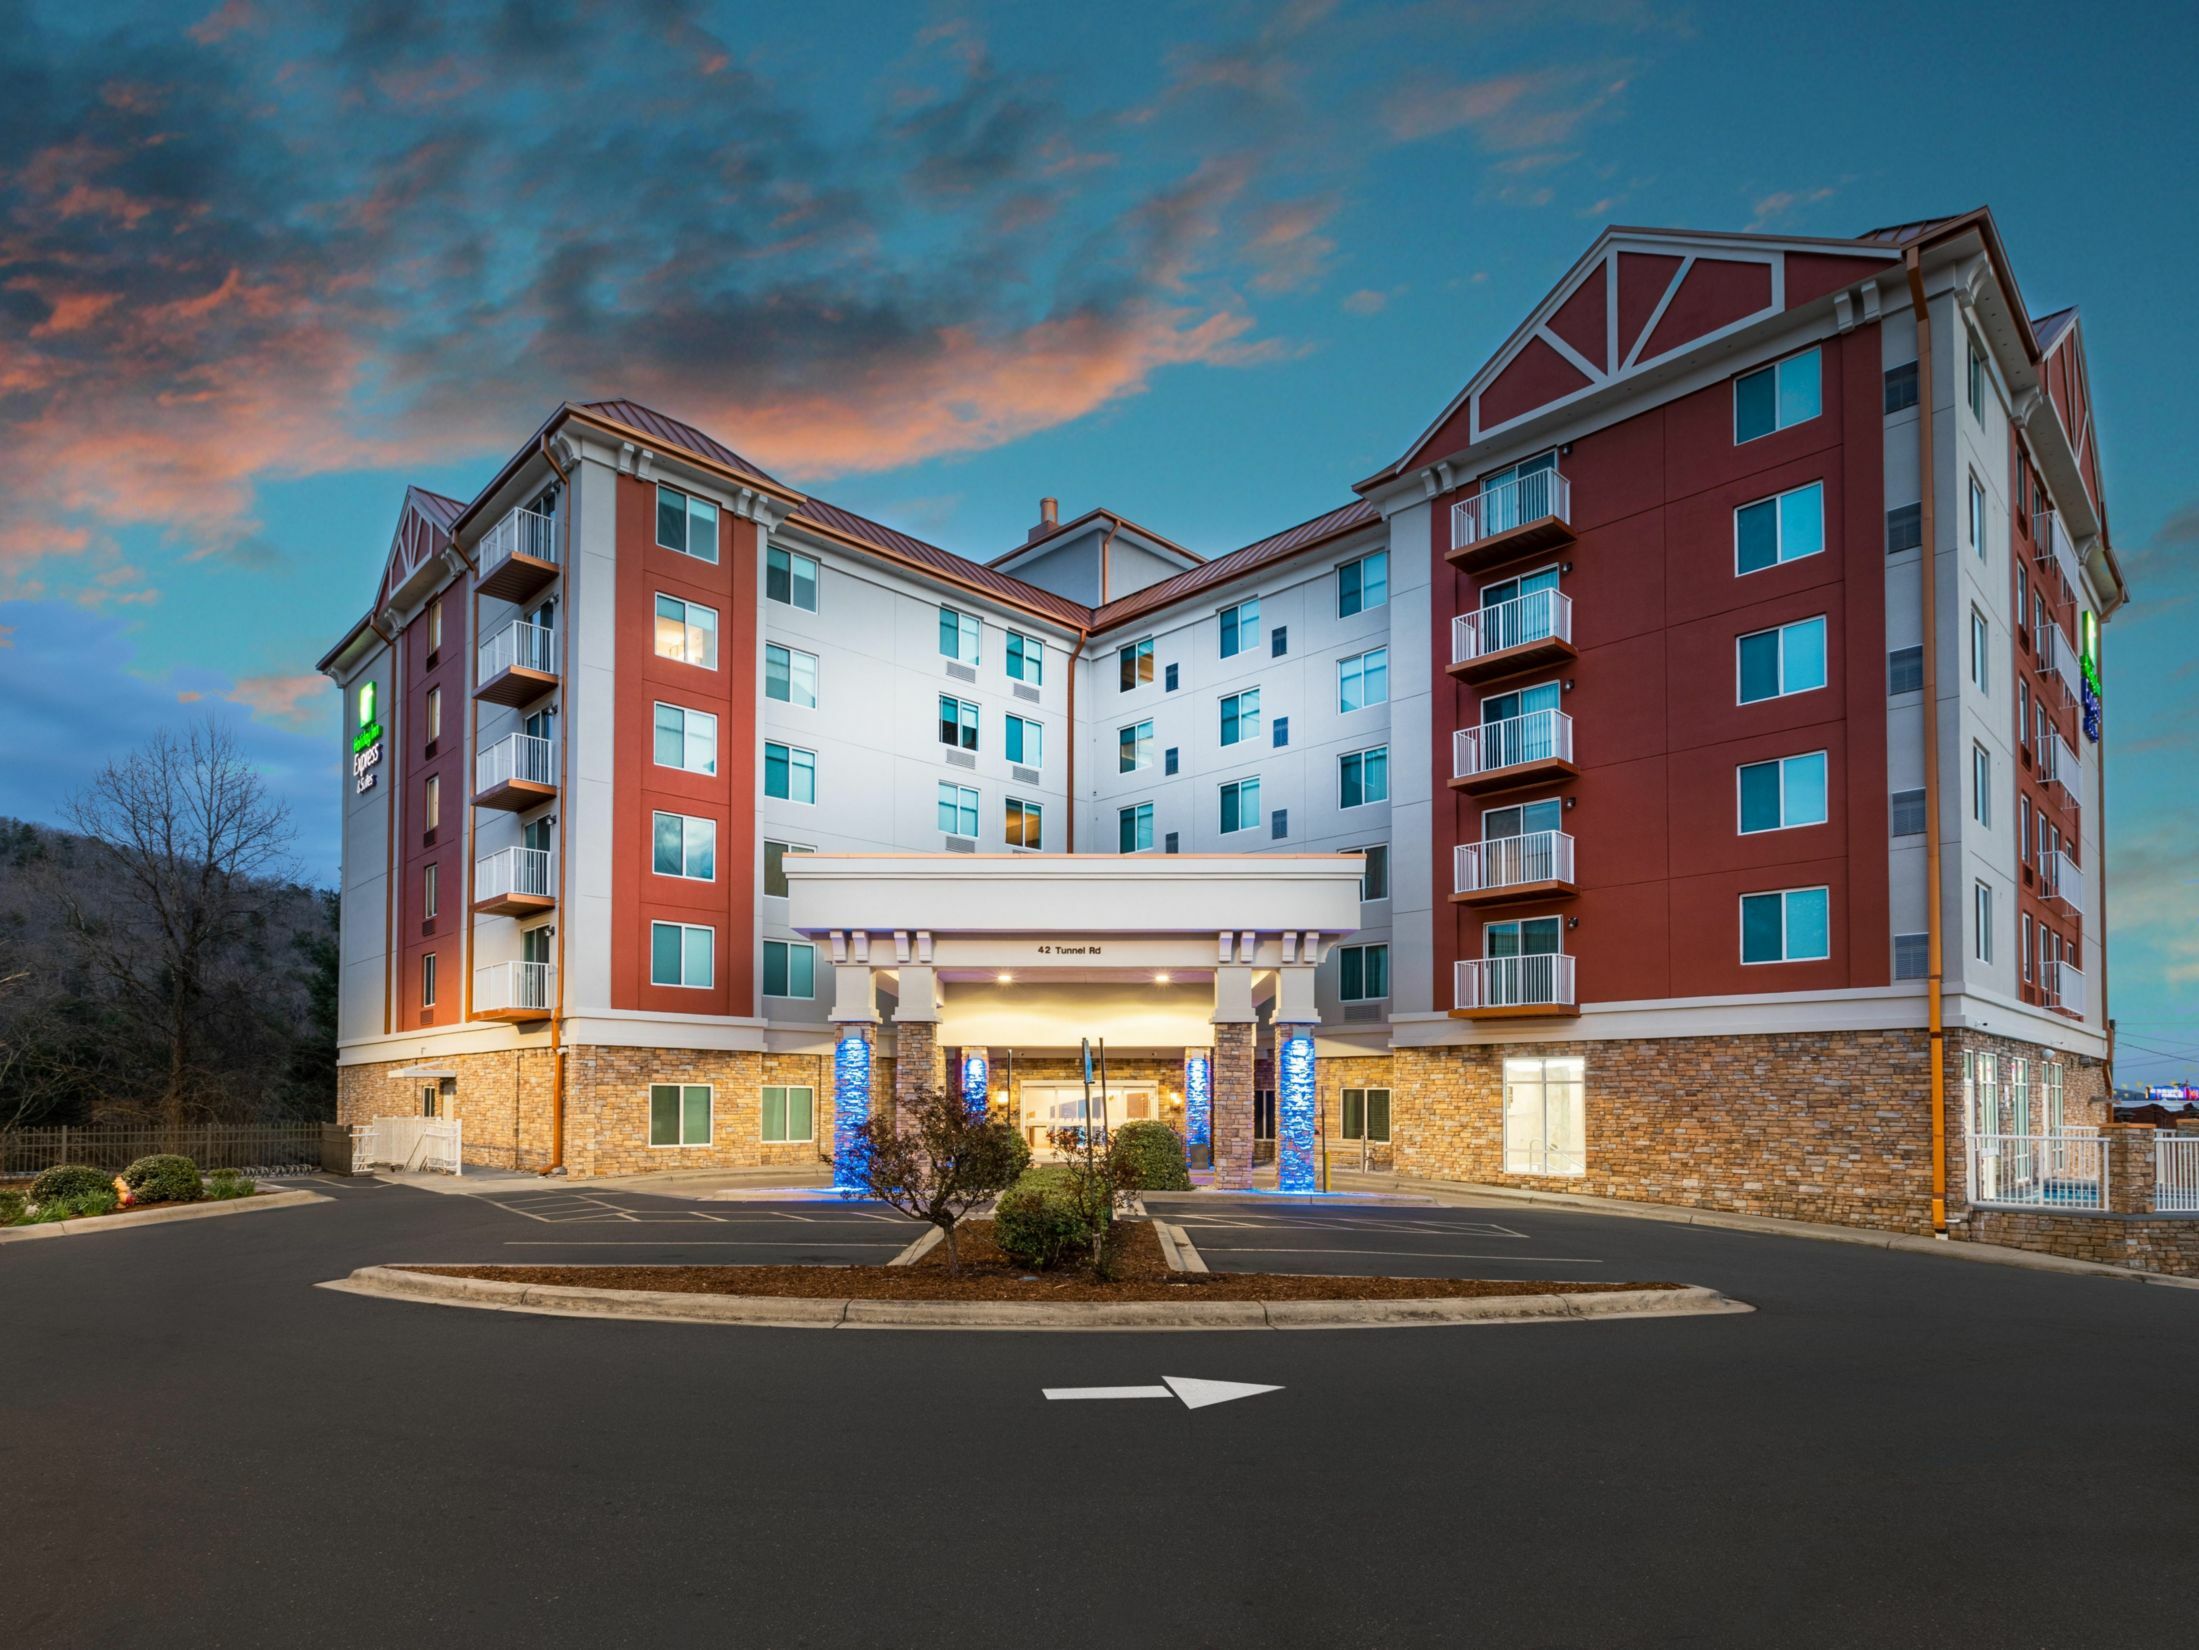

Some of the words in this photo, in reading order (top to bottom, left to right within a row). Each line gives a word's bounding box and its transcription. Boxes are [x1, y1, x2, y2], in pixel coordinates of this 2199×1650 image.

[353, 743, 379, 777] Express
[1037, 946, 1051, 954] 42
[1055, 946, 1086, 954] Tunnel
[1089, 946, 1101, 954] Rd
